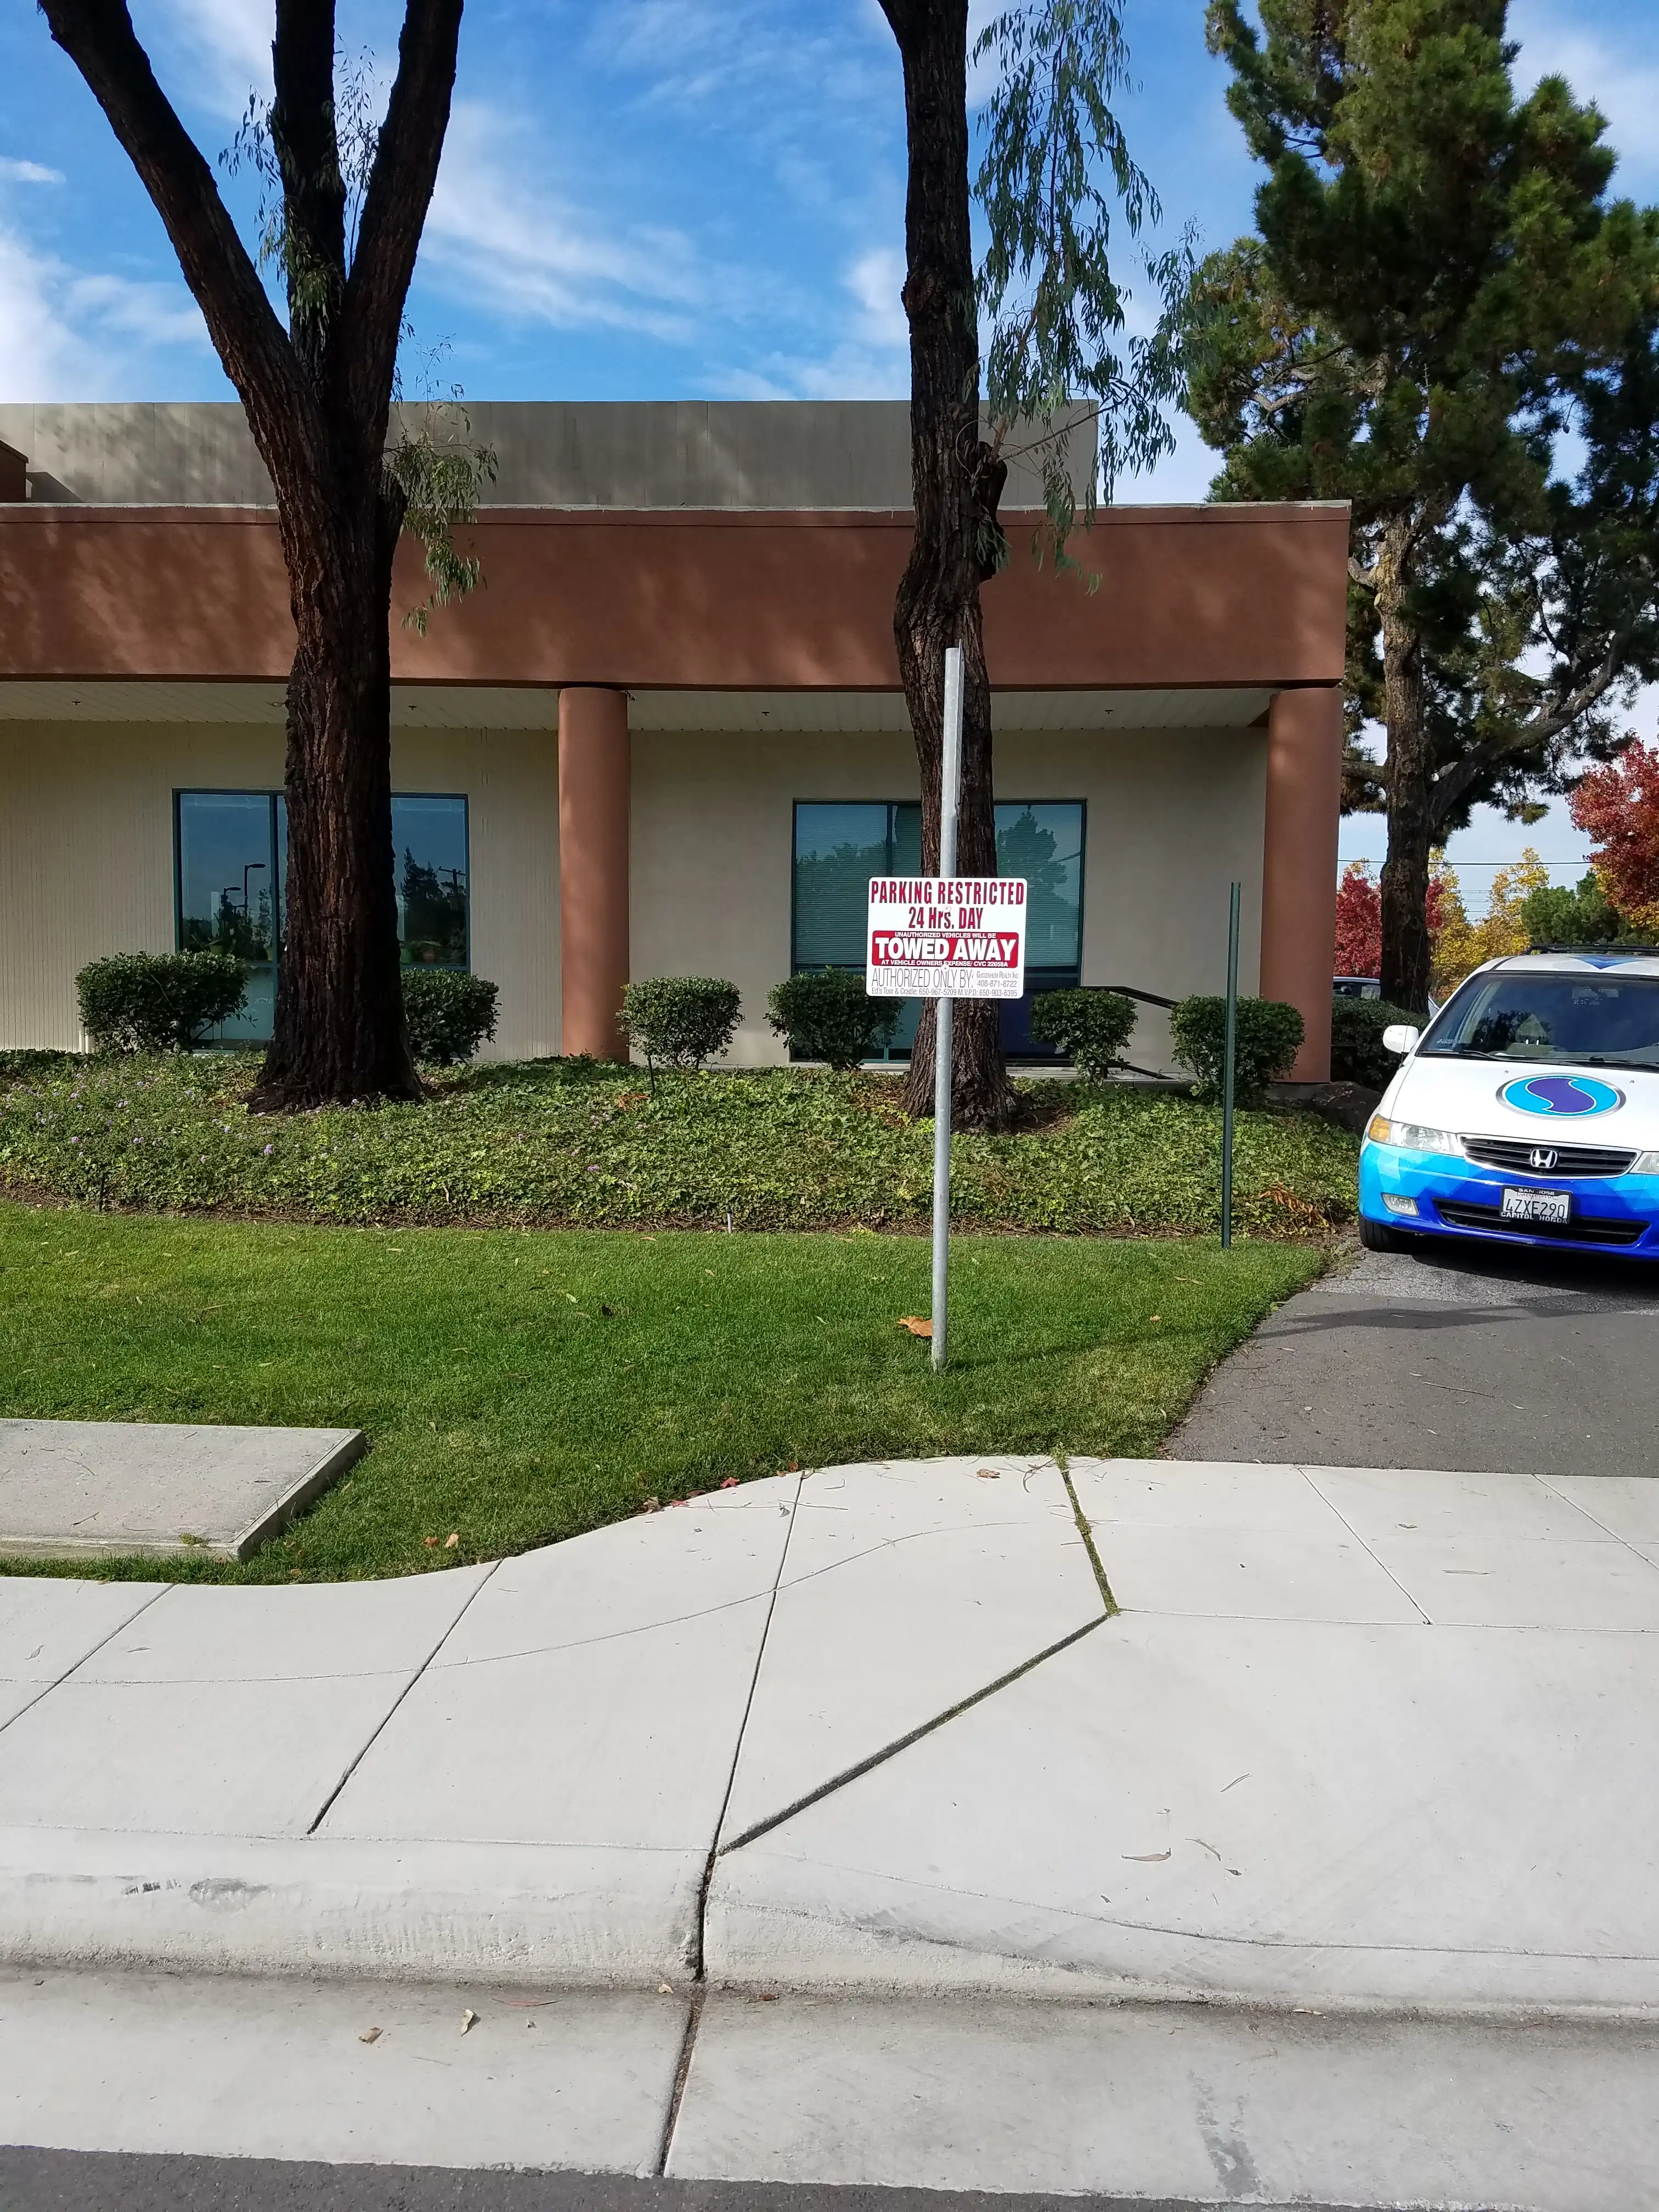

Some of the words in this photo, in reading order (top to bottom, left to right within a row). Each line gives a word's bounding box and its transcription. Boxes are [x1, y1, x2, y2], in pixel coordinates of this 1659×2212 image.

[871, 881, 932, 904] PARKING
[938, 882, 1024, 905] RESTRICTED
[909, 906, 924, 928] 24
[928, 907, 955, 929] Hrs.
[958, 907, 984, 929] DAY
[875, 938, 949, 960] TOWED
[952, 939, 1016, 961] AWAY
[872, 968, 930, 987] AUTHORIZED
[934, 969, 959, 988] ONLY
[1505, 1198, 1565, 1218] 4ZXE290
[1539, 1216, 1567, 1224] HONDA
